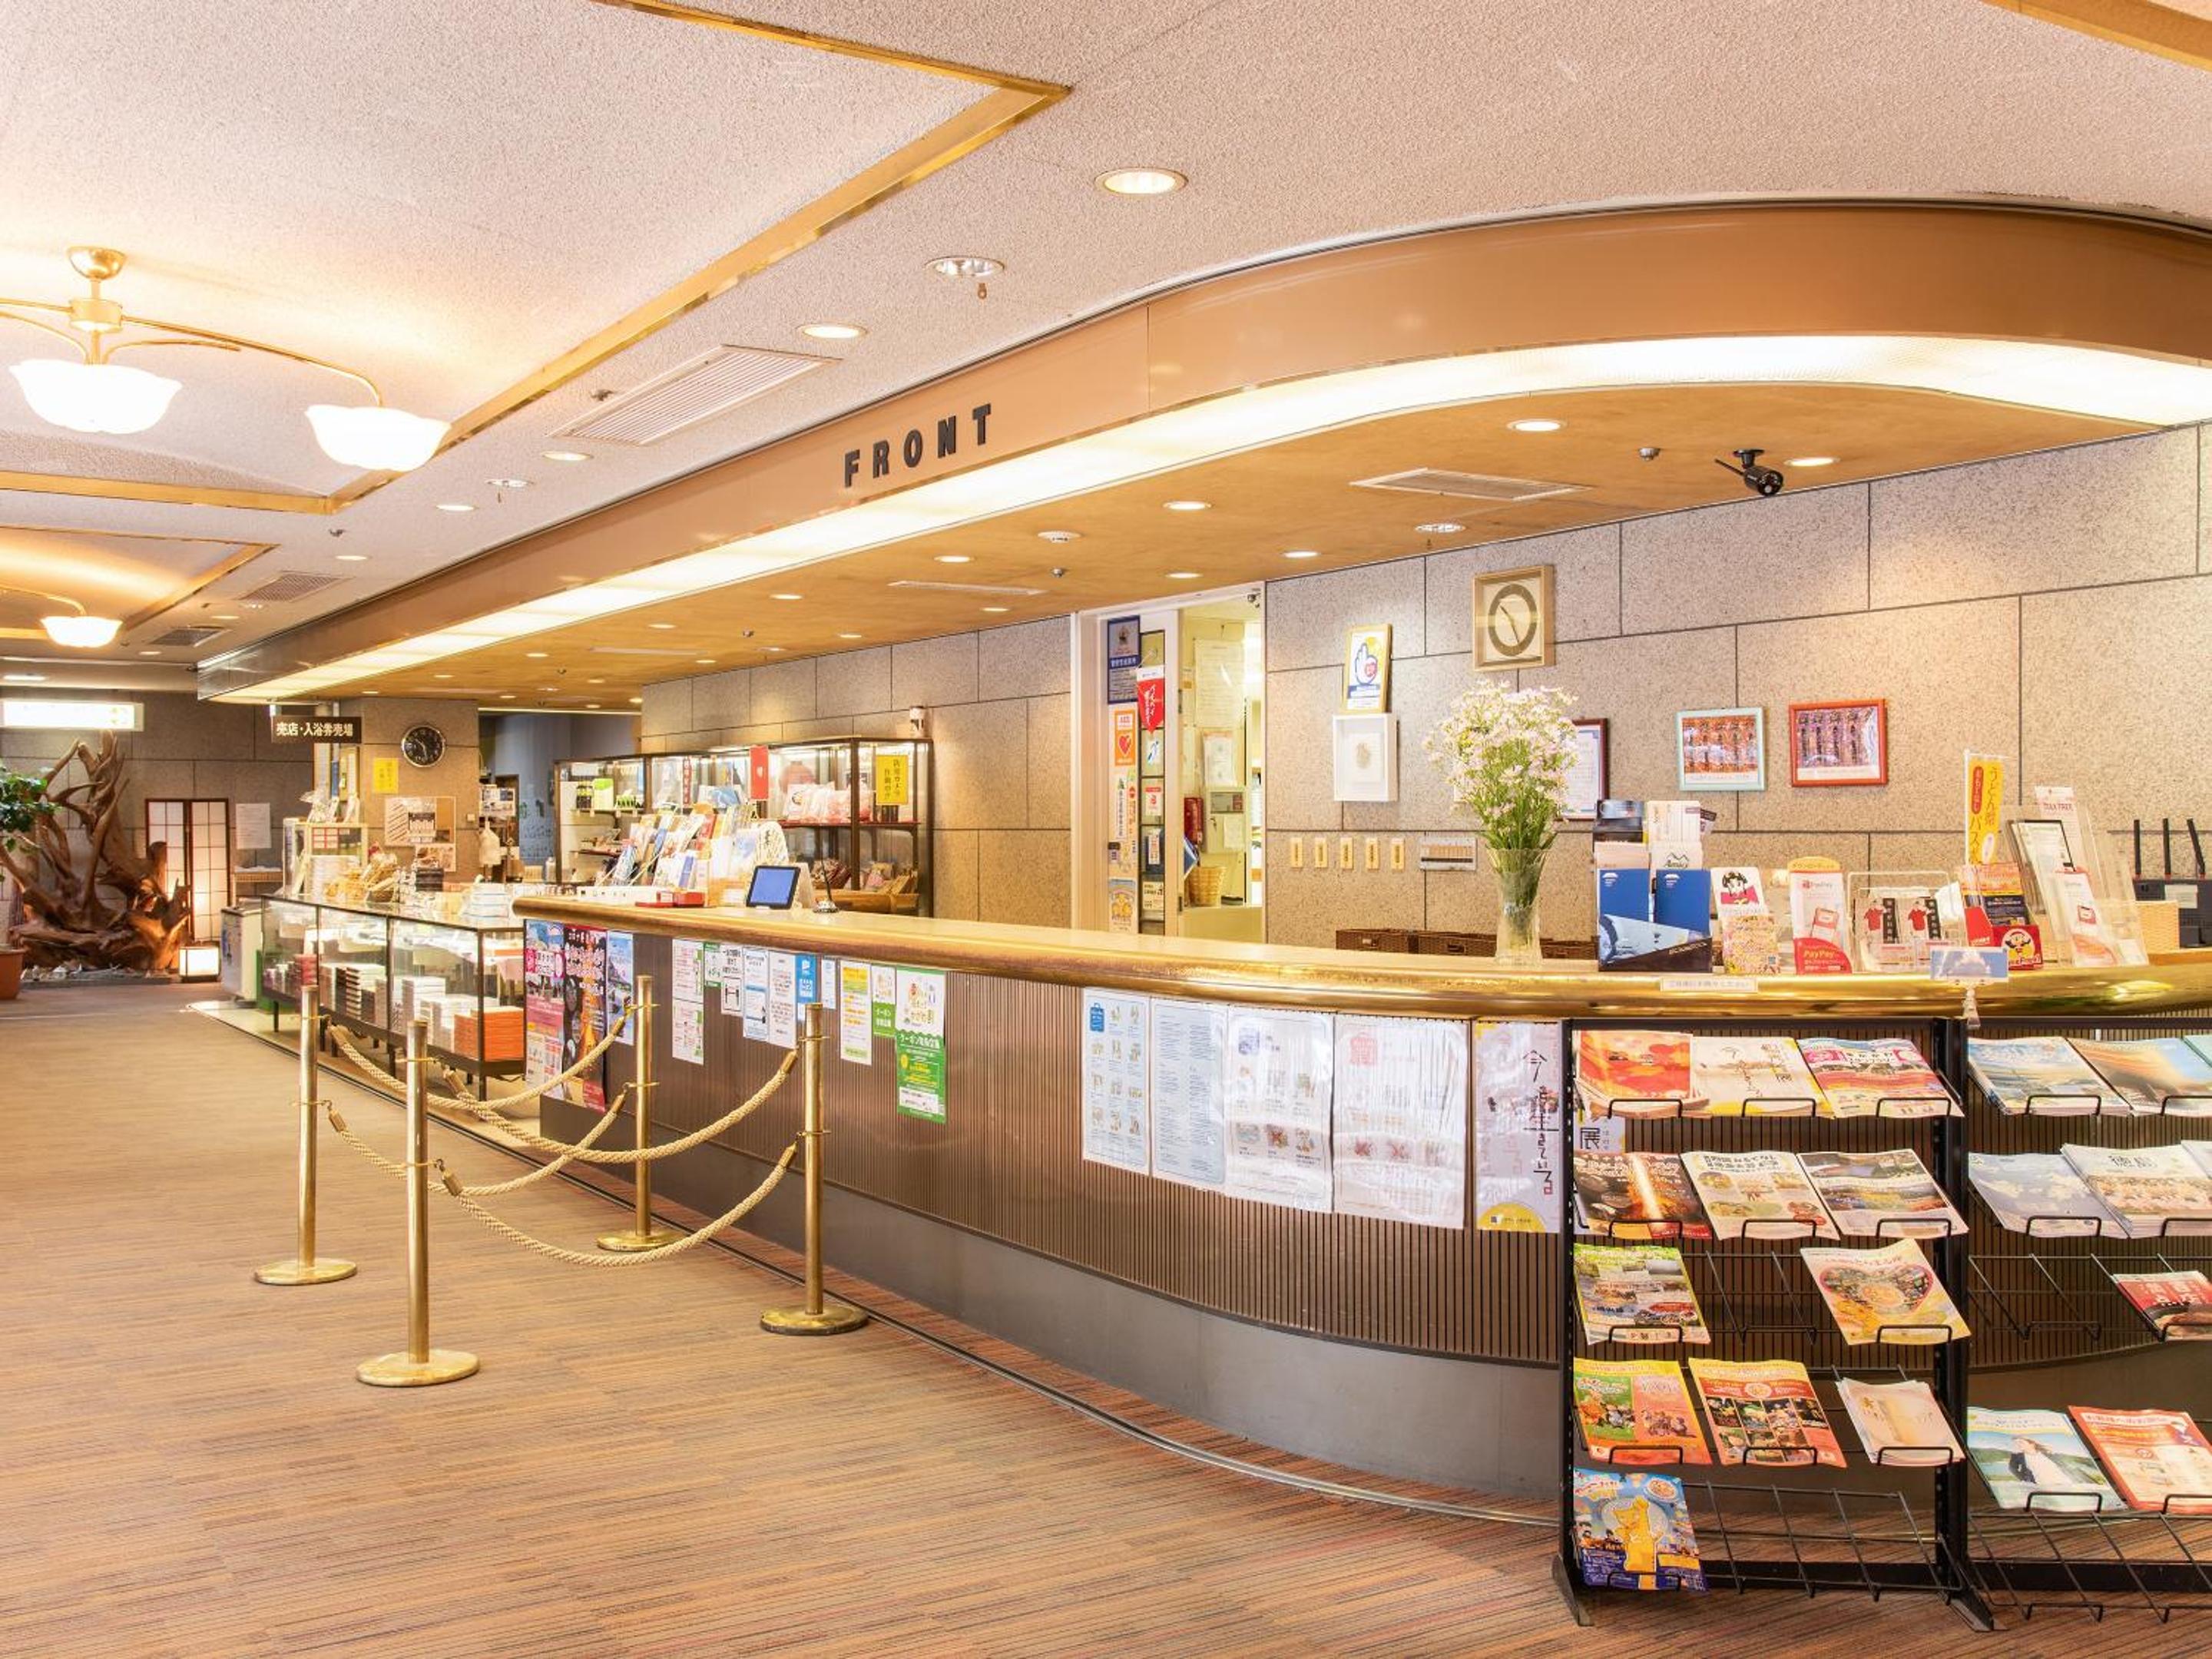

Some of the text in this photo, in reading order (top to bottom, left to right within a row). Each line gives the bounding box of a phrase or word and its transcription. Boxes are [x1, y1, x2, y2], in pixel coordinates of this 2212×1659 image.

[845, 403, 991, 488] FRONT
[276, 722, 353, 737] 売店・入浴券売場
[1805, 950, 1835, 959] PayPay
